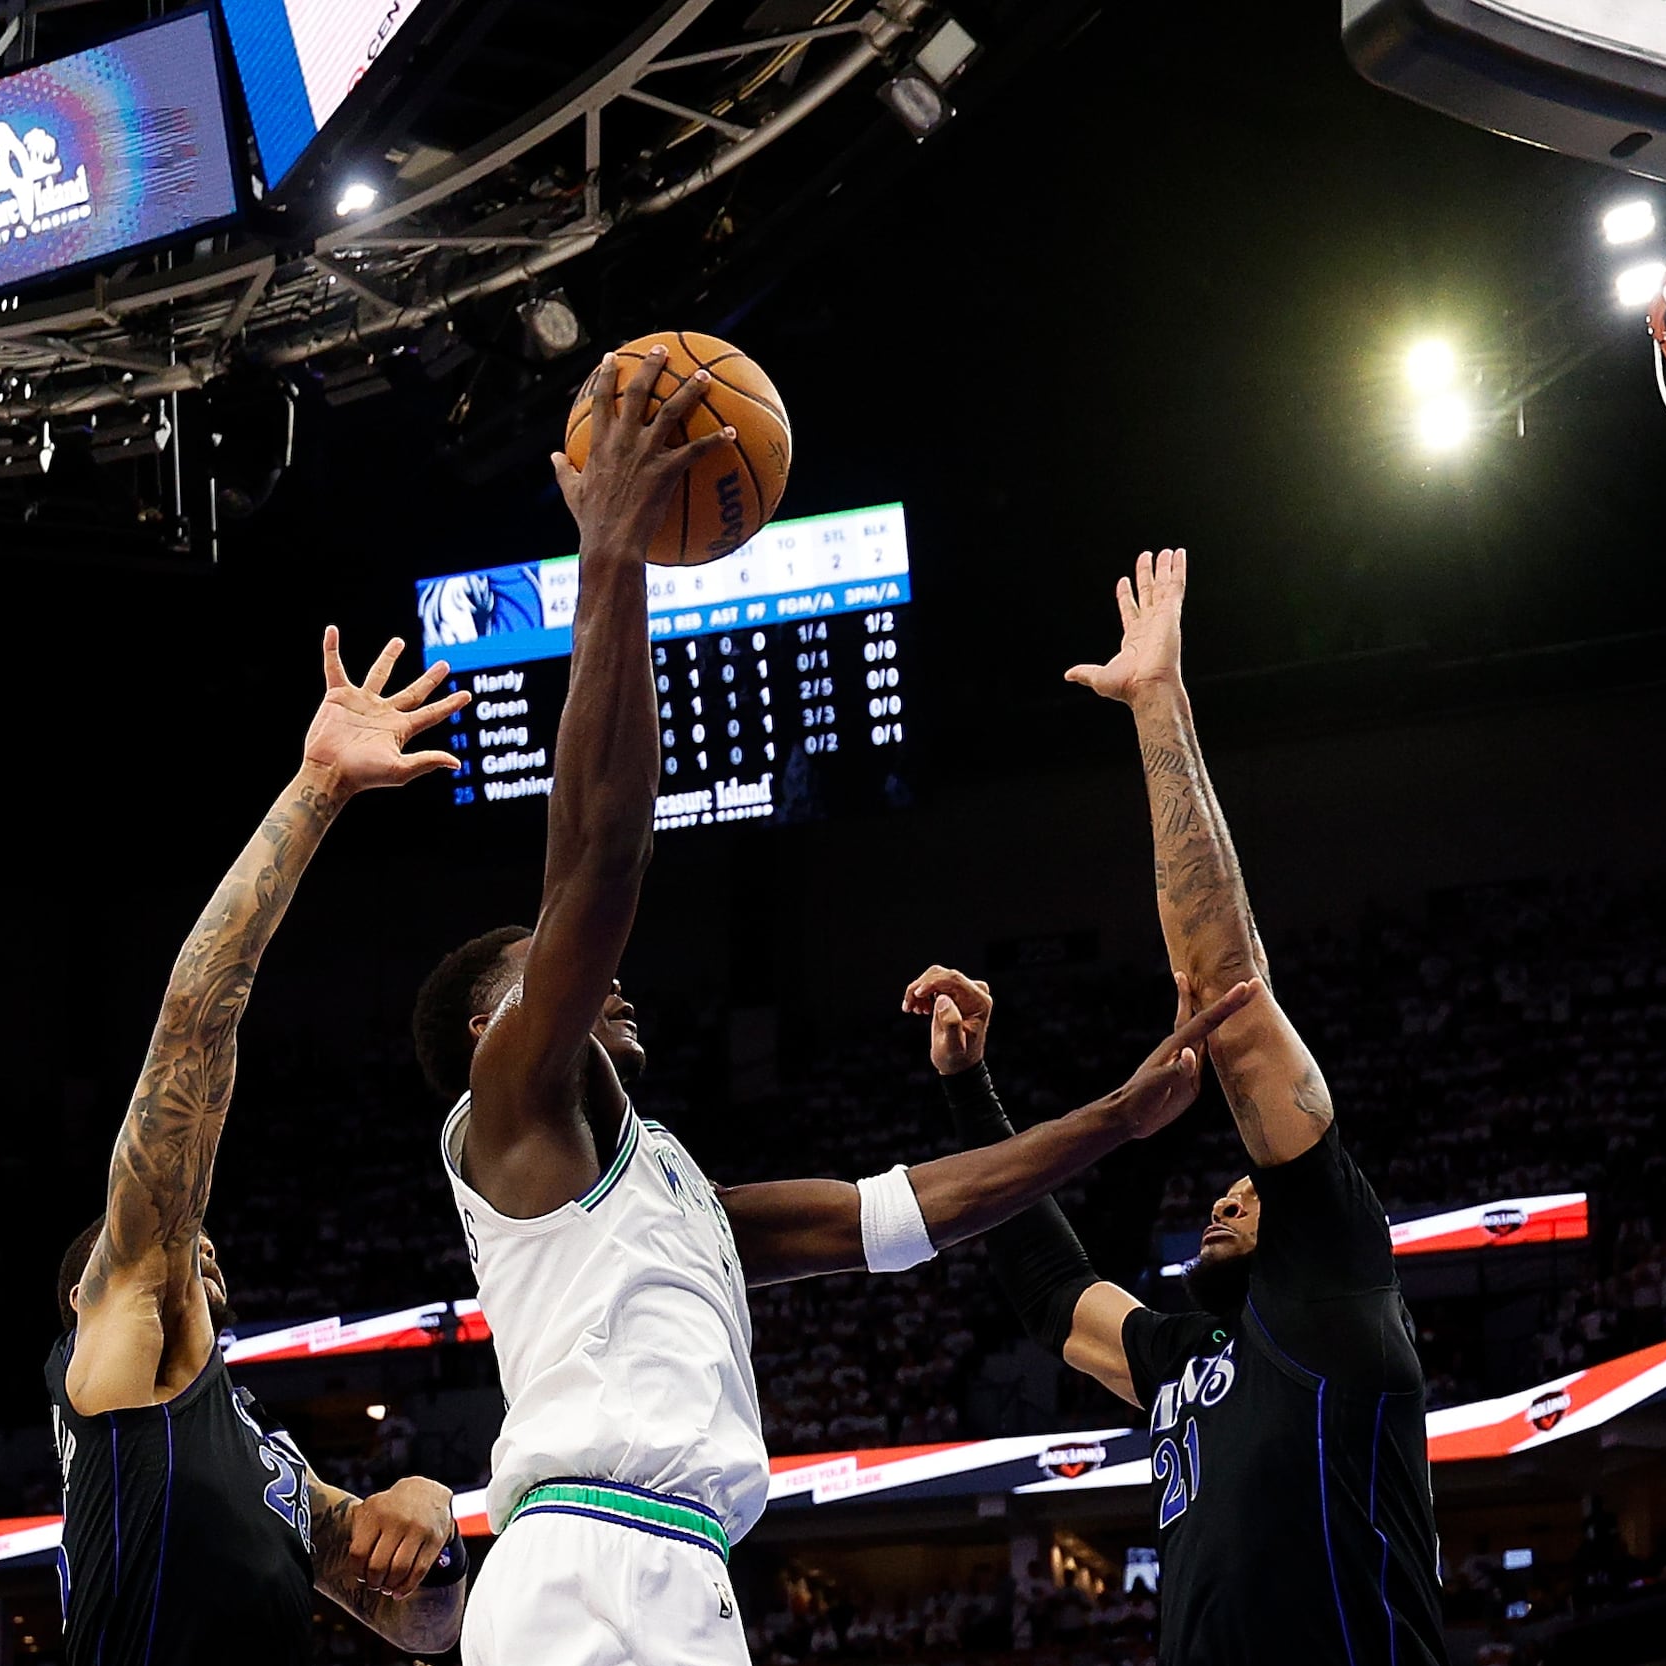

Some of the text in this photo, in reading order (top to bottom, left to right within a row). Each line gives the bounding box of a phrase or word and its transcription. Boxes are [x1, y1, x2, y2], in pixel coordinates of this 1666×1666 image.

[34, 164, 90, 216] Island
[685, 640, 696, 661] 1
[719, 636, 732, 655] 0
[752, 631, 766, 651] 0
[797, 621, 828, 644] 1/4
[864, 611, 894, 634] 1/2
[473, 670, 524, 694] Hardy
[657, 639, 897, 693] 0 1 0 1 0/1 0/0
[476, 699, 528, 721] Green
[691, 695, 702, 716] 1
[727, 691, 737, 710] 1
[759, 686, 770, 706] 1
[799, 677, 833, 700] 2/5
[866, 667, 899, 690] 0/0
[479, 726, 528, 748] Irving
[692, 723, 705, 743] 0
[727, 719, 740, 738] 0
[762, 714, 773, 734] 1
[802, 705, 835, 727] 3/3
[869, 695, 902, 718] 0/0
[482, 747, 546, 775] Gafford
[665, 722, 903, 775] 0 1 0 1 0/2 0/1
[1153, 1416, 1201, 1530] 21
